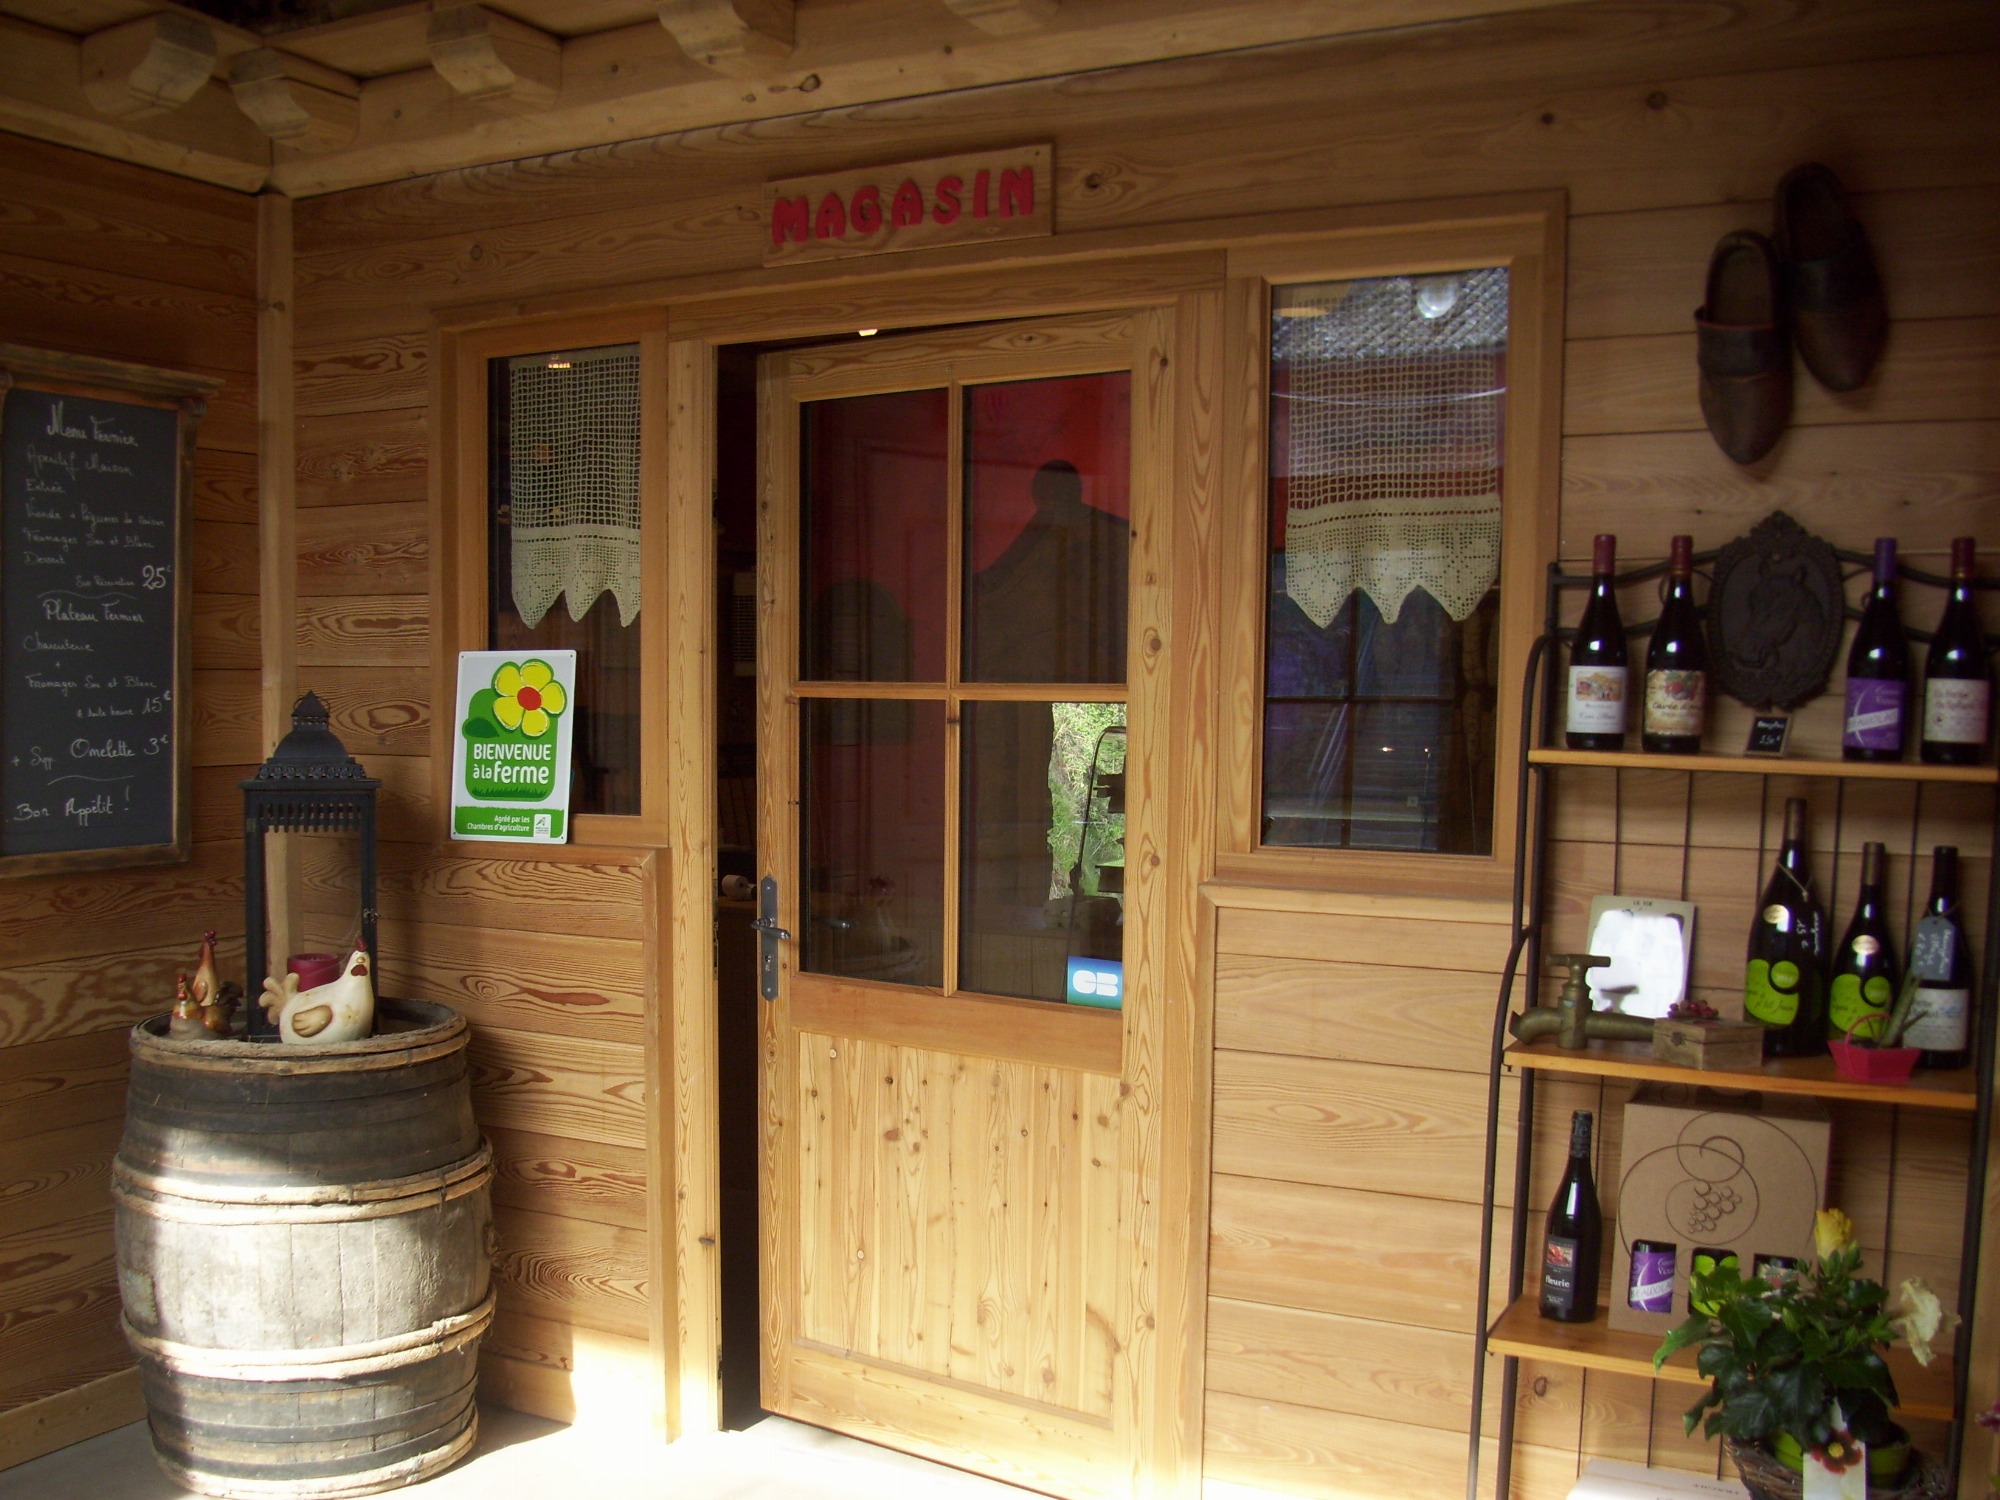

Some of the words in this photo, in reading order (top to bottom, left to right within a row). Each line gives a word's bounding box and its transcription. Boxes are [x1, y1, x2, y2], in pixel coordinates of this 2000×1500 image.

[772, 167, 1034, 246] MAGASIN
[47, 400, 87, 440] Menu
[43, 599, 98, 623] Plateau
[25, 673, 77, 697] Fromages
[108, 677, 119, 689] et
[70, 738, 136, 759] Omelette
[473, 743, 552, 761] BIENVENUE
[473, 764, 480, 780] à
[481, 765, 492, 780] la
[493, 761, 550, 785] ferme
[13, 803, 50, 822] Bon
[494, 815, 511, 824] Agréé
[511, 816, 521, 824] par
[467, 822, 494, 831] Chambres
[494, 823, 530, 832] d'agriculture
[1072, 969, 1118, 997] CB
[1545, 1274, 1570, 1289] fleurie
